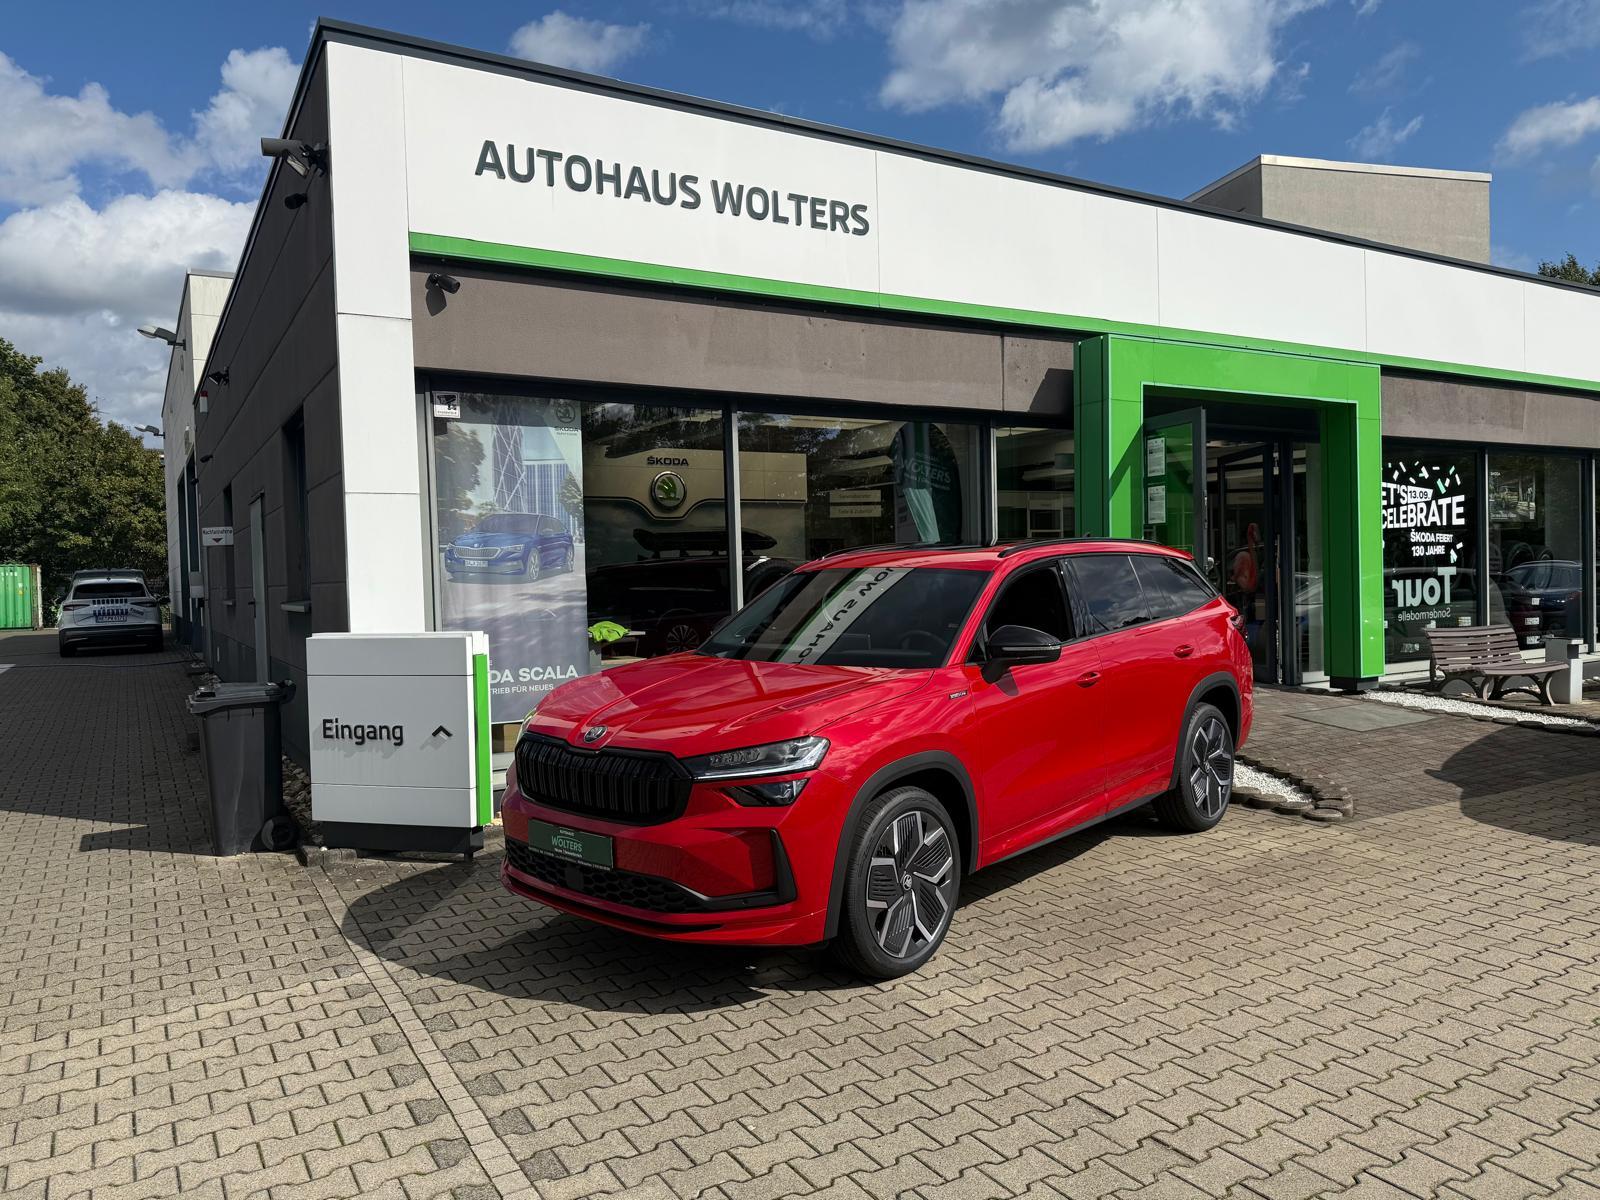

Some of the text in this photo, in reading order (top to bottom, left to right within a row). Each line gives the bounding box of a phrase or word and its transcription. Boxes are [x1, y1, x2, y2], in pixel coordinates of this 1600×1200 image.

[475, 139, 870, 236] AUTOHAUS WOLTERS
[647, 456, 689, 466] ŠKODA
[1411, 529, 1454, 543] ŠKODA FEIERT
[1412, 545, 1446, 557] 130 JAHRE
[518, 664, 579, 681] SCALA
[511, 684, 528, 693] FÜR
[529, 683, 554, 692] NEUES
[322, 718, 404, 746] Eingang
[551, 836, 583, 852] WOLTERS
